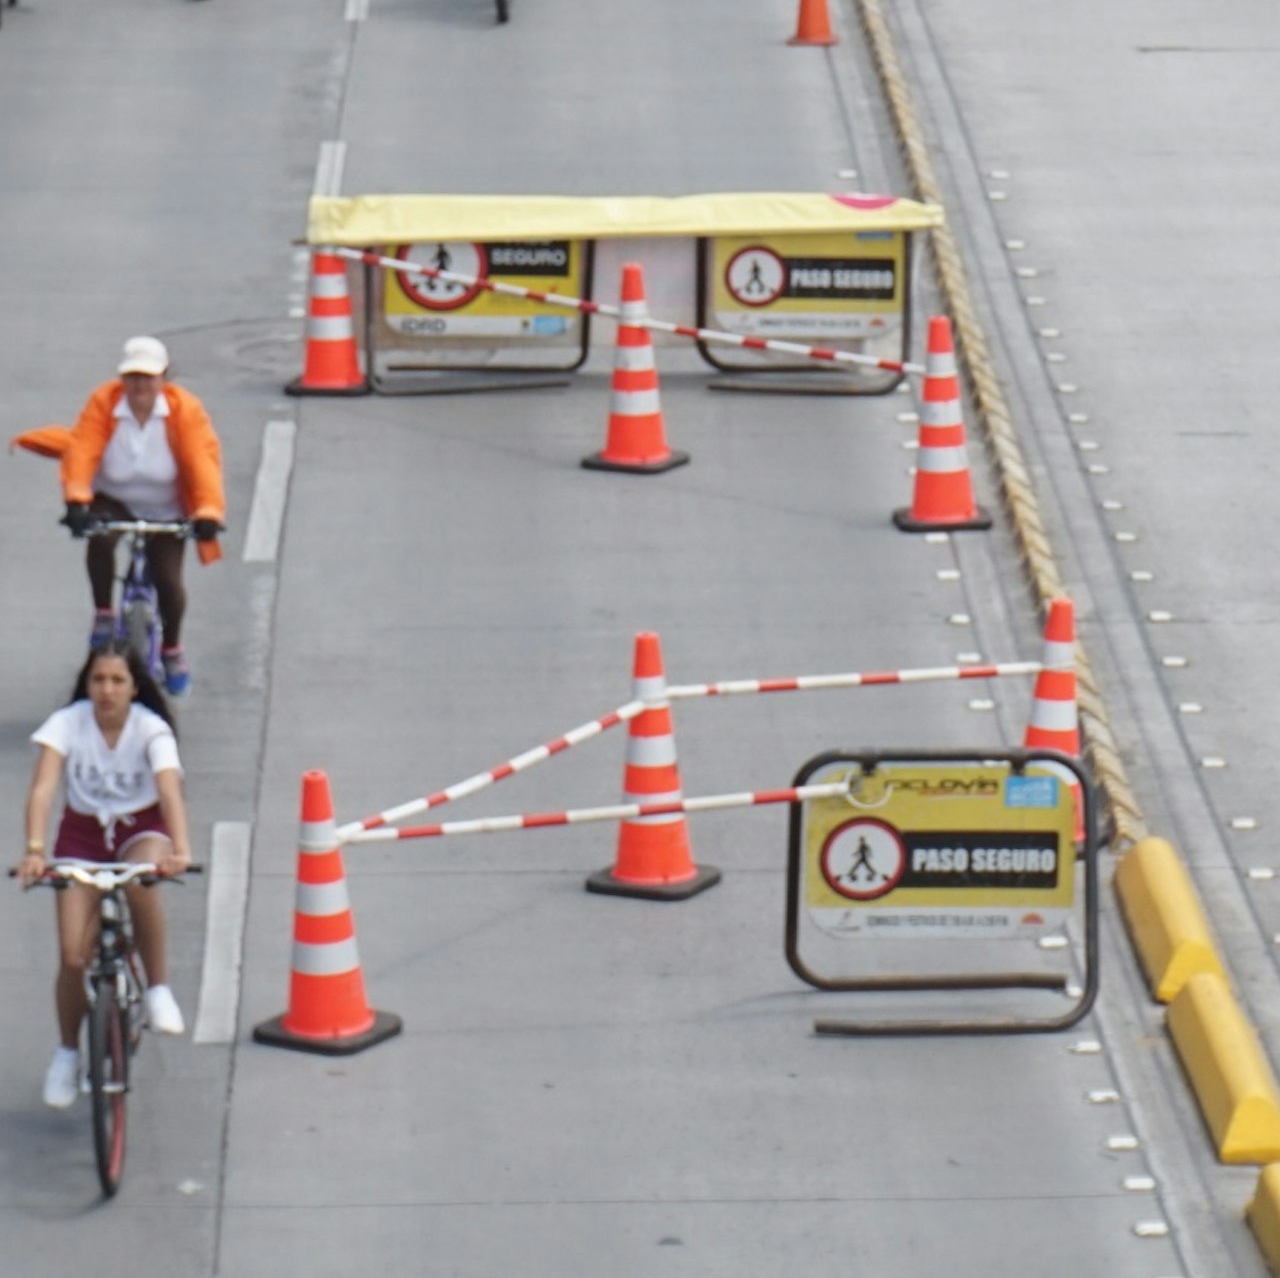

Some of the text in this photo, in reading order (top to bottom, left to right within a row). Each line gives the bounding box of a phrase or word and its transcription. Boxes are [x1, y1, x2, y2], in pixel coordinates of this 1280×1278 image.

[491, 248, 567, 266] SEGURO
[790, 269, 894, 289] PASO SEGURO
[912, 848, 1056, 872] PASO SEGURO
